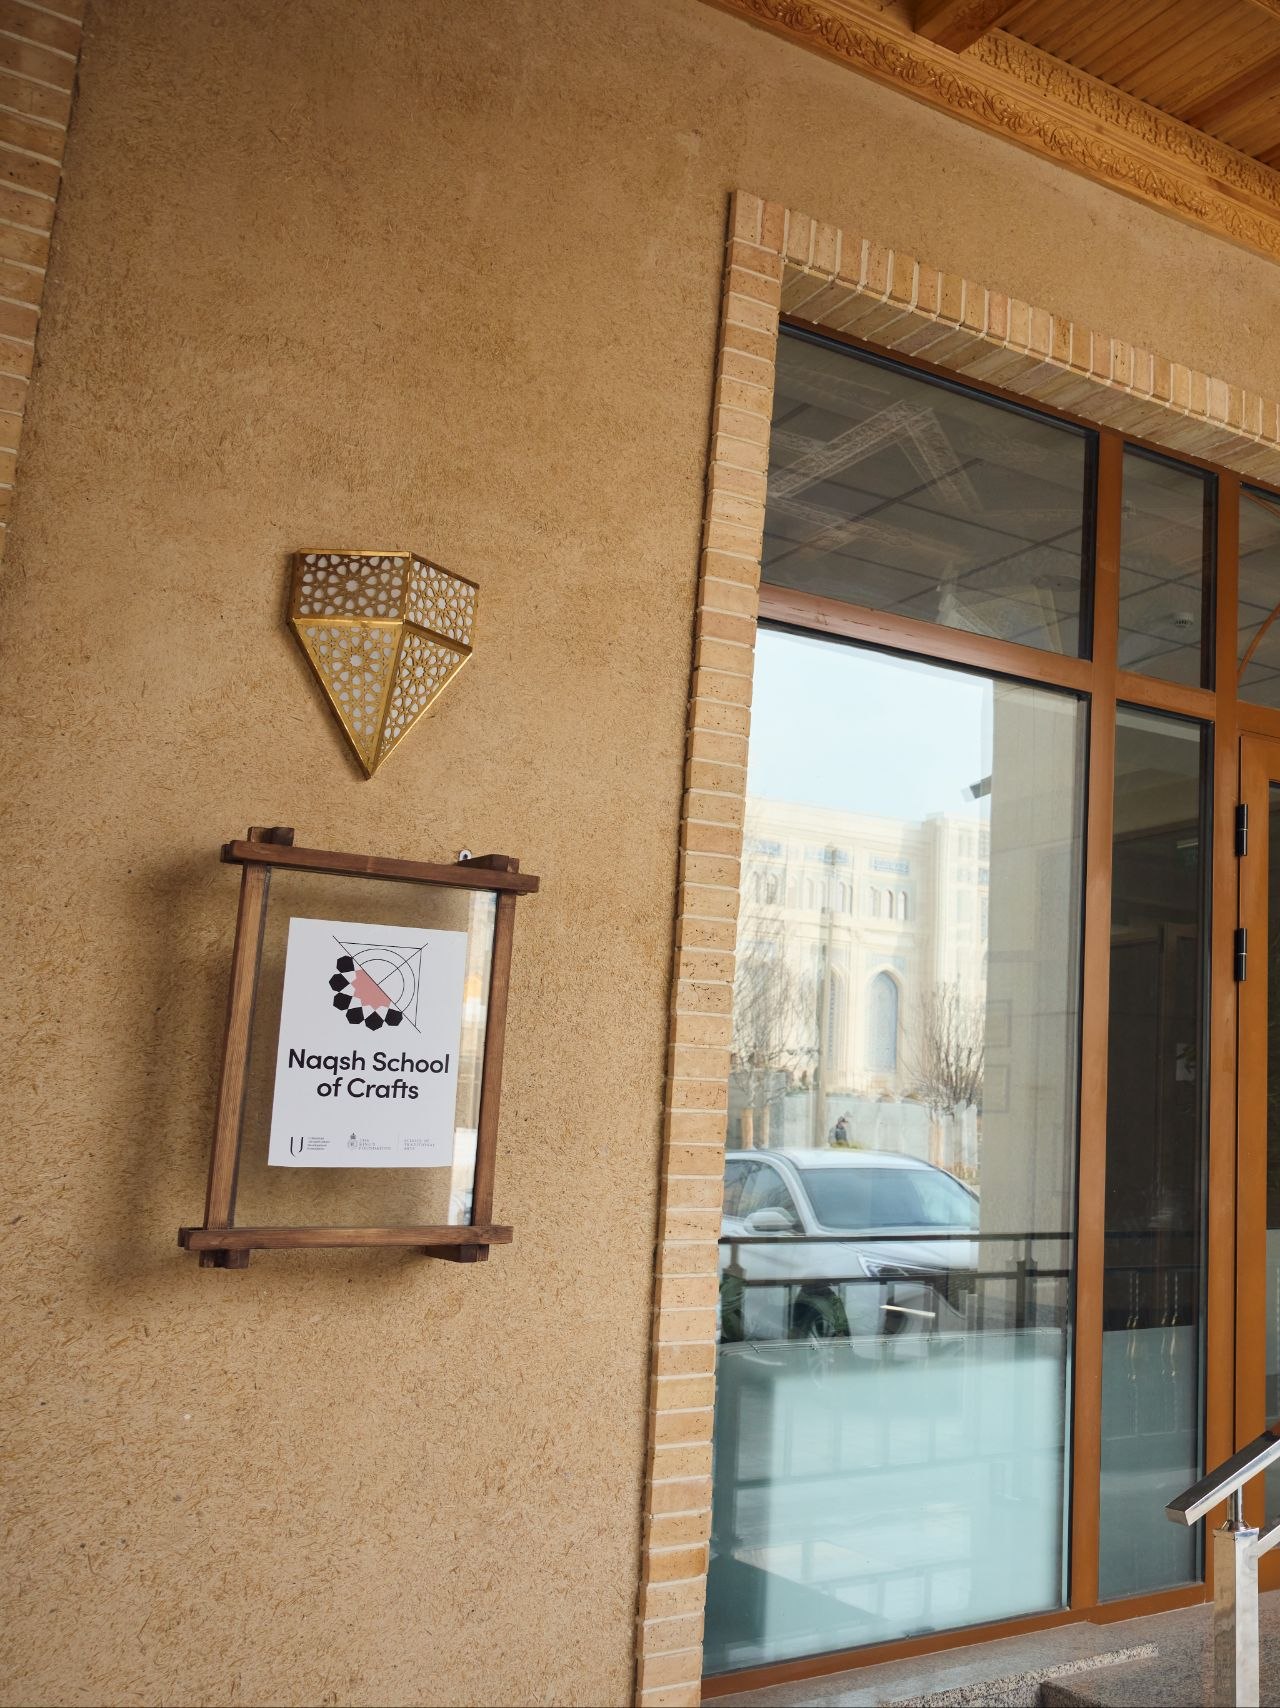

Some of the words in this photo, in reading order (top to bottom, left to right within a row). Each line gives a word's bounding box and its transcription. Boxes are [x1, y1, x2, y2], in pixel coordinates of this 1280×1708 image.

[288, 1048, 366, 1076] Naqsh
[372, 1051, 450, 1074] School
[316, 1076, 344, 1098] of
[347, 1077, 419, 1100] Crafts
